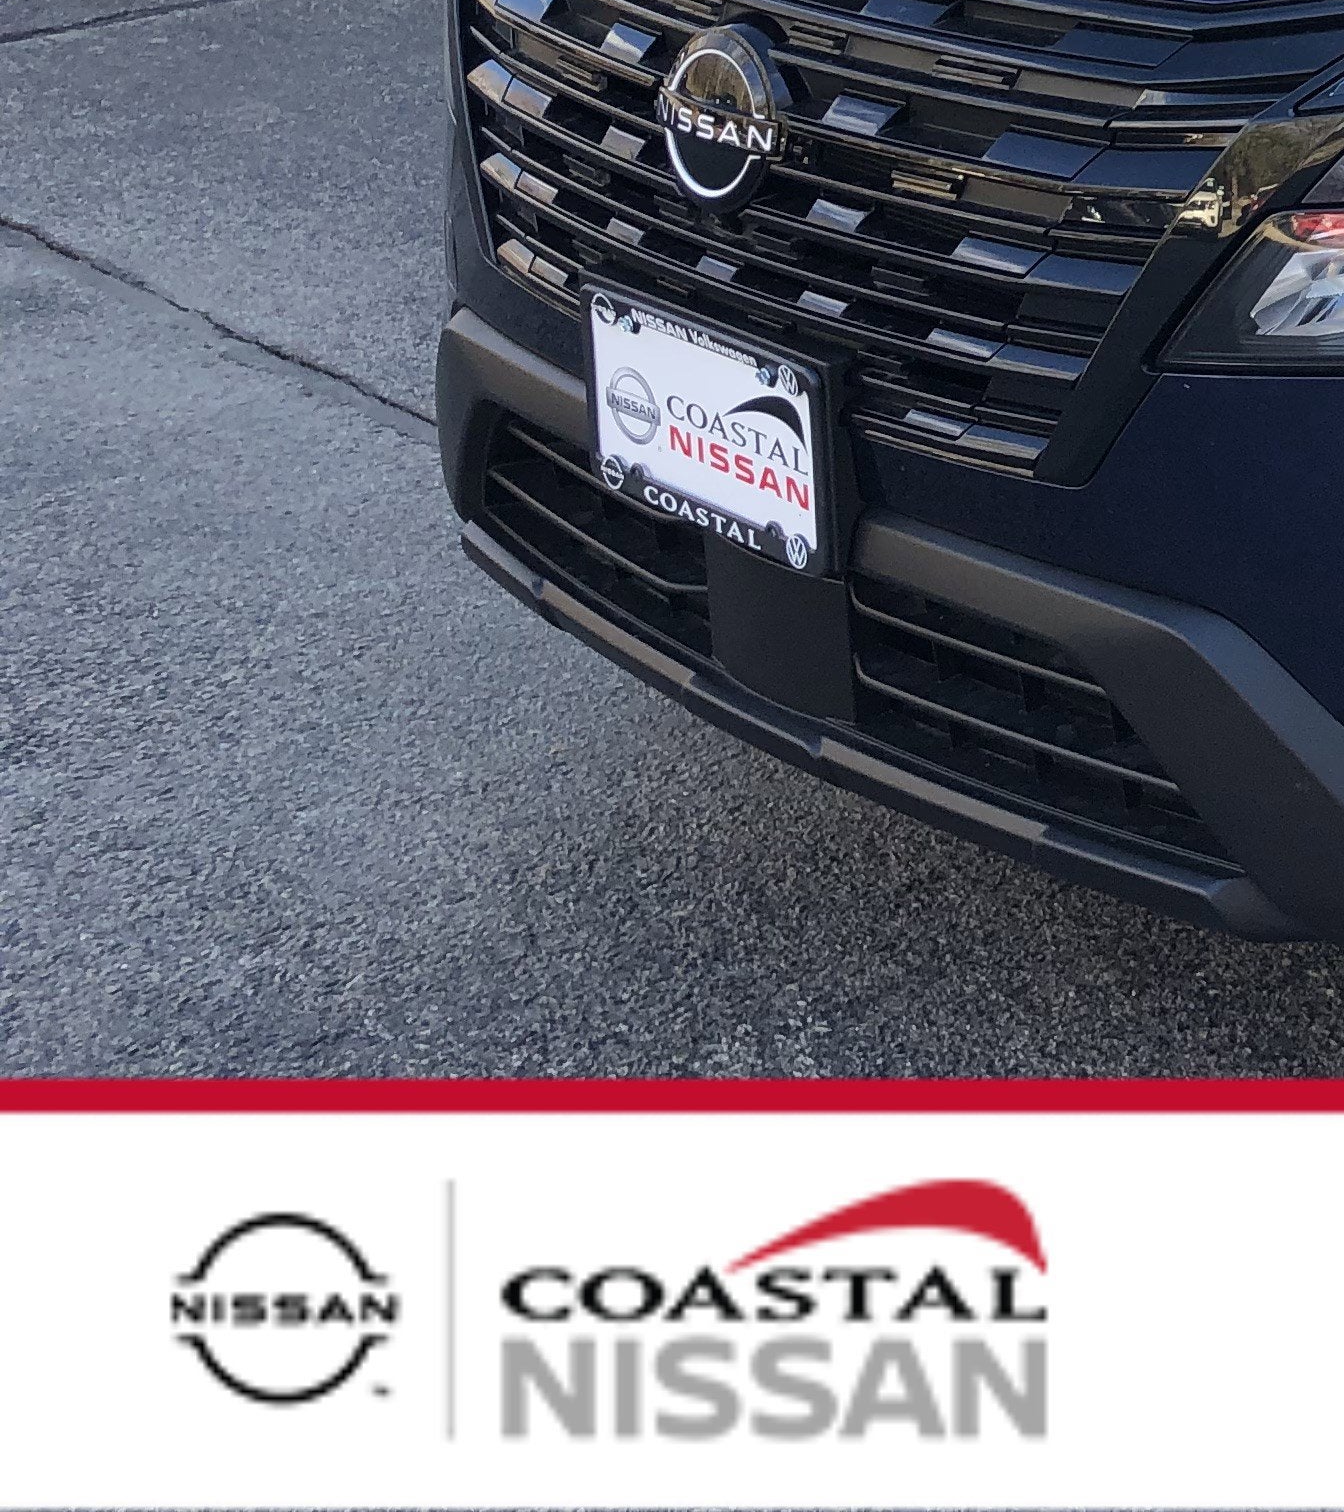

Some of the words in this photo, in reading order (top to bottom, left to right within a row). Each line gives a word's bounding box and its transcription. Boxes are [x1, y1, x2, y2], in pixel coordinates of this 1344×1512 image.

[656, 93, 773, 152] NISSAN
[630, 308, 688, 341] NISSAN
[689, 328, 758, 367] Volkswagen
[610, 388, 657, 421] NISSAN
[666, 395, 809, 477] COASTAL
[668, 424, 810, 512] NISSAN
[643, 484, 762, 551] COASTAL
